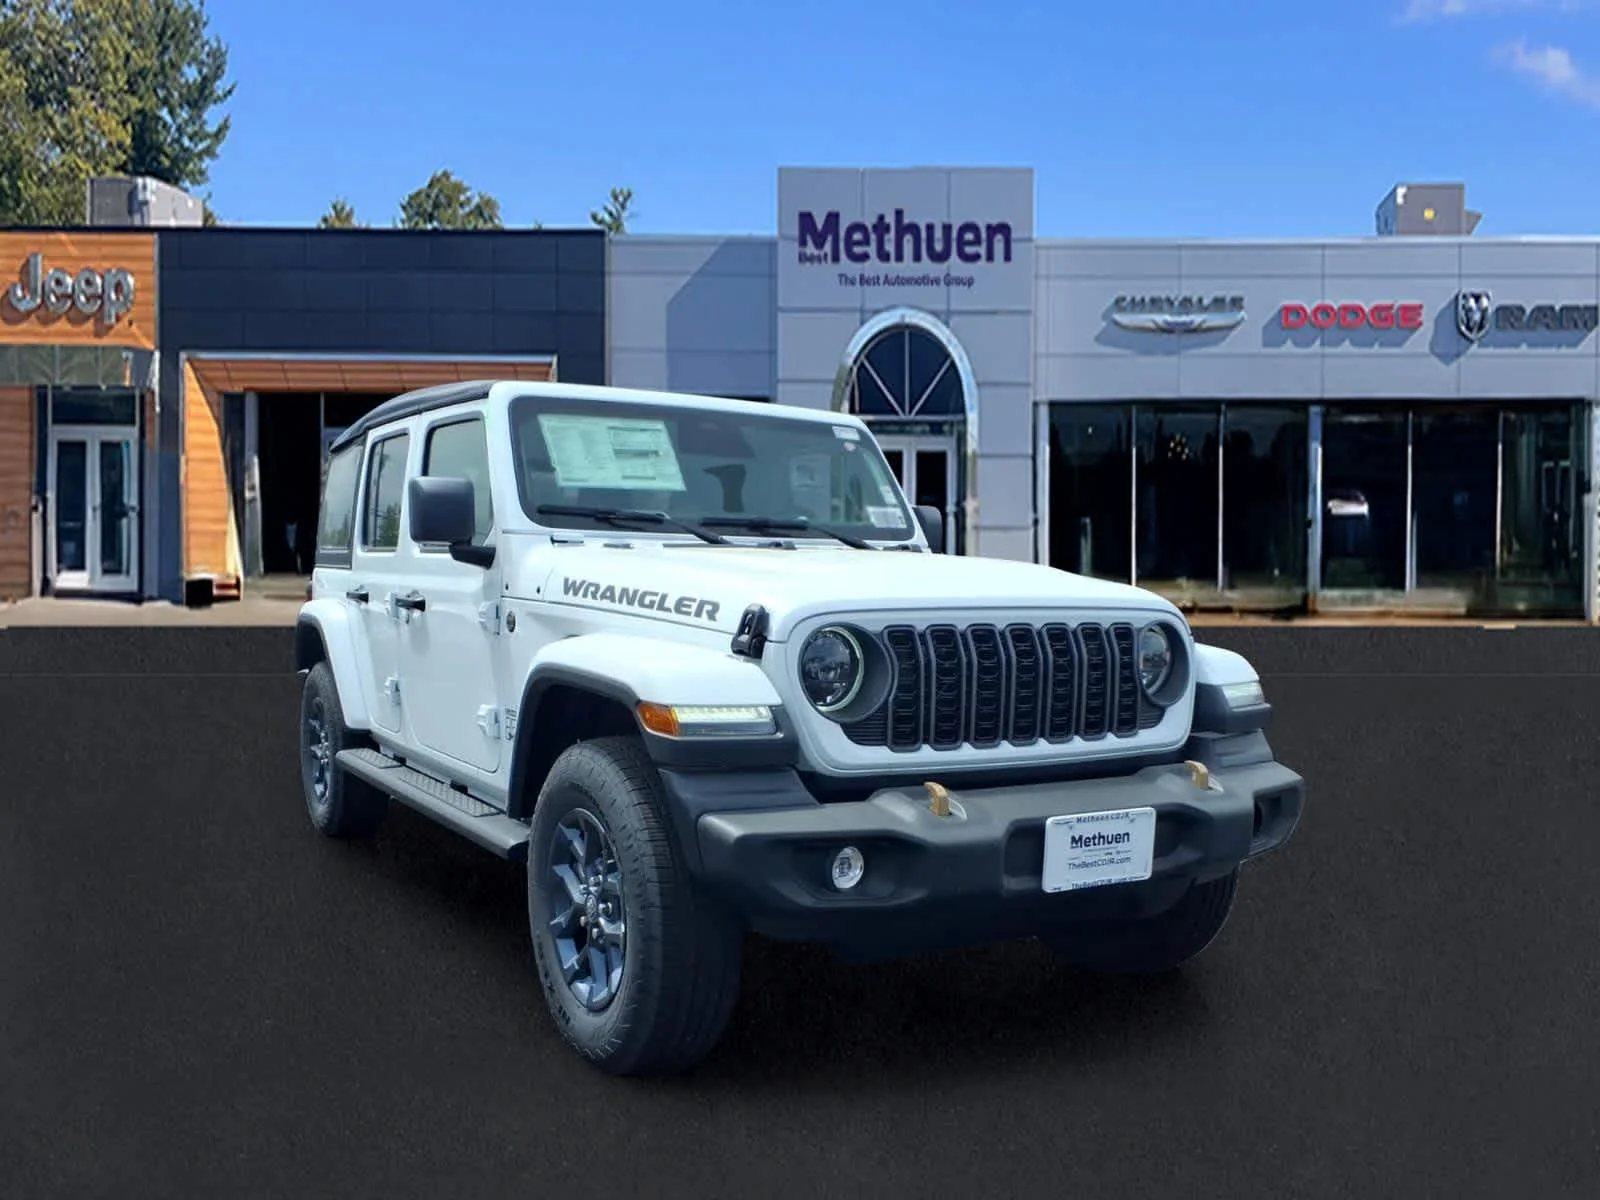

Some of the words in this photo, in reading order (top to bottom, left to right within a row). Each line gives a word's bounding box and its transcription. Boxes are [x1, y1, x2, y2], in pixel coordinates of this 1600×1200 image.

[798, 209, 1012, 264] Methuen
[9, 252, 135, 326] Jeep
[838, 273, 857, 286] The
[859, 273, 881, 286] Best
[883, 273, 941, 286] Automotive
[943, 273, 975, 289] Group
[1281, 303, 1424, 329] DODGE
[1494, 304, 1598, 331] RAM
[563, 576, 721, 622] WRANGLER
[1070, 831, 1131, 849] Methuen
